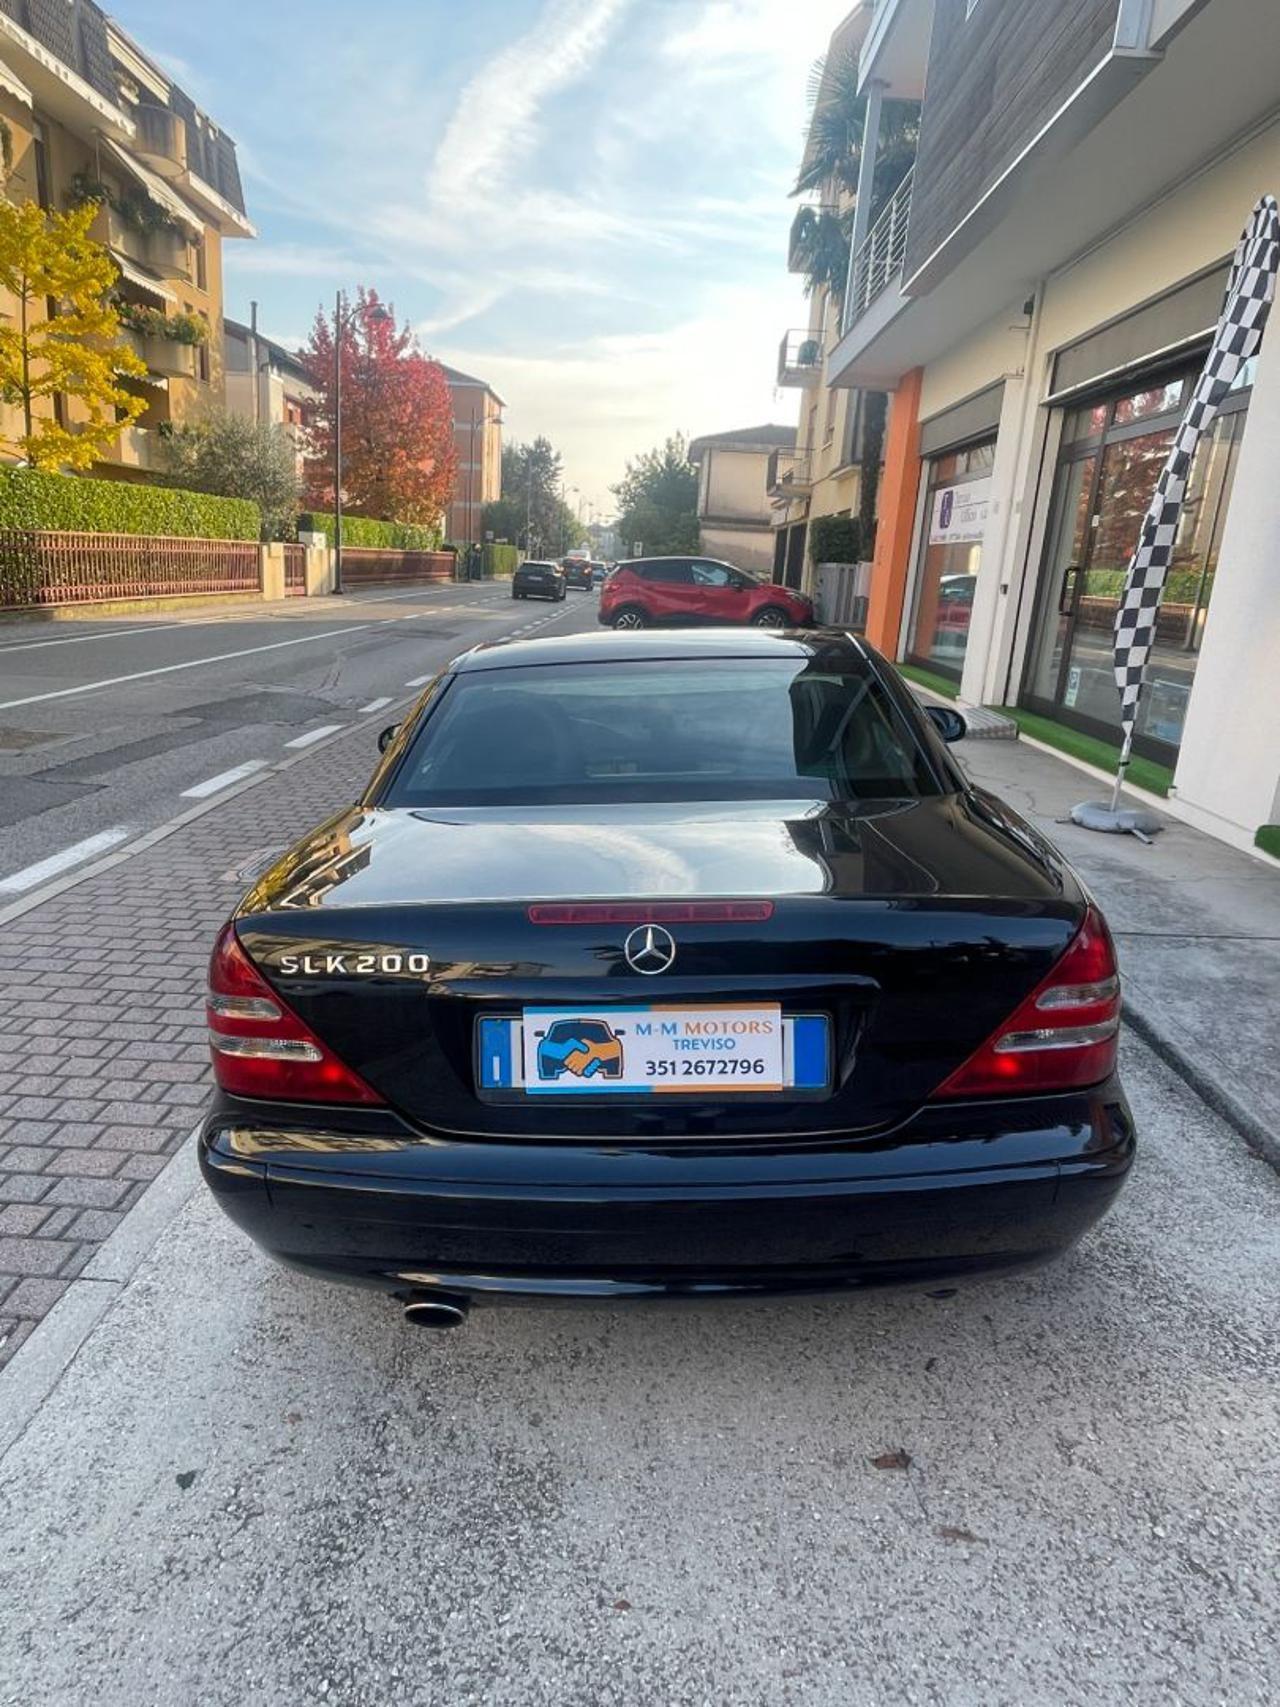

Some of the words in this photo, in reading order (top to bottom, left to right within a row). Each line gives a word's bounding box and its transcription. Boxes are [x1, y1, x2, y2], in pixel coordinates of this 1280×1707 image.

[280, 956, 347, 974] SLK
[356, 954, 430, 973] 200
[635, 1022, 678, 1035] M-M
[685, 1020, 773, 1035] MOTORS
[673, 1038, 736, 1050] TREVISO
